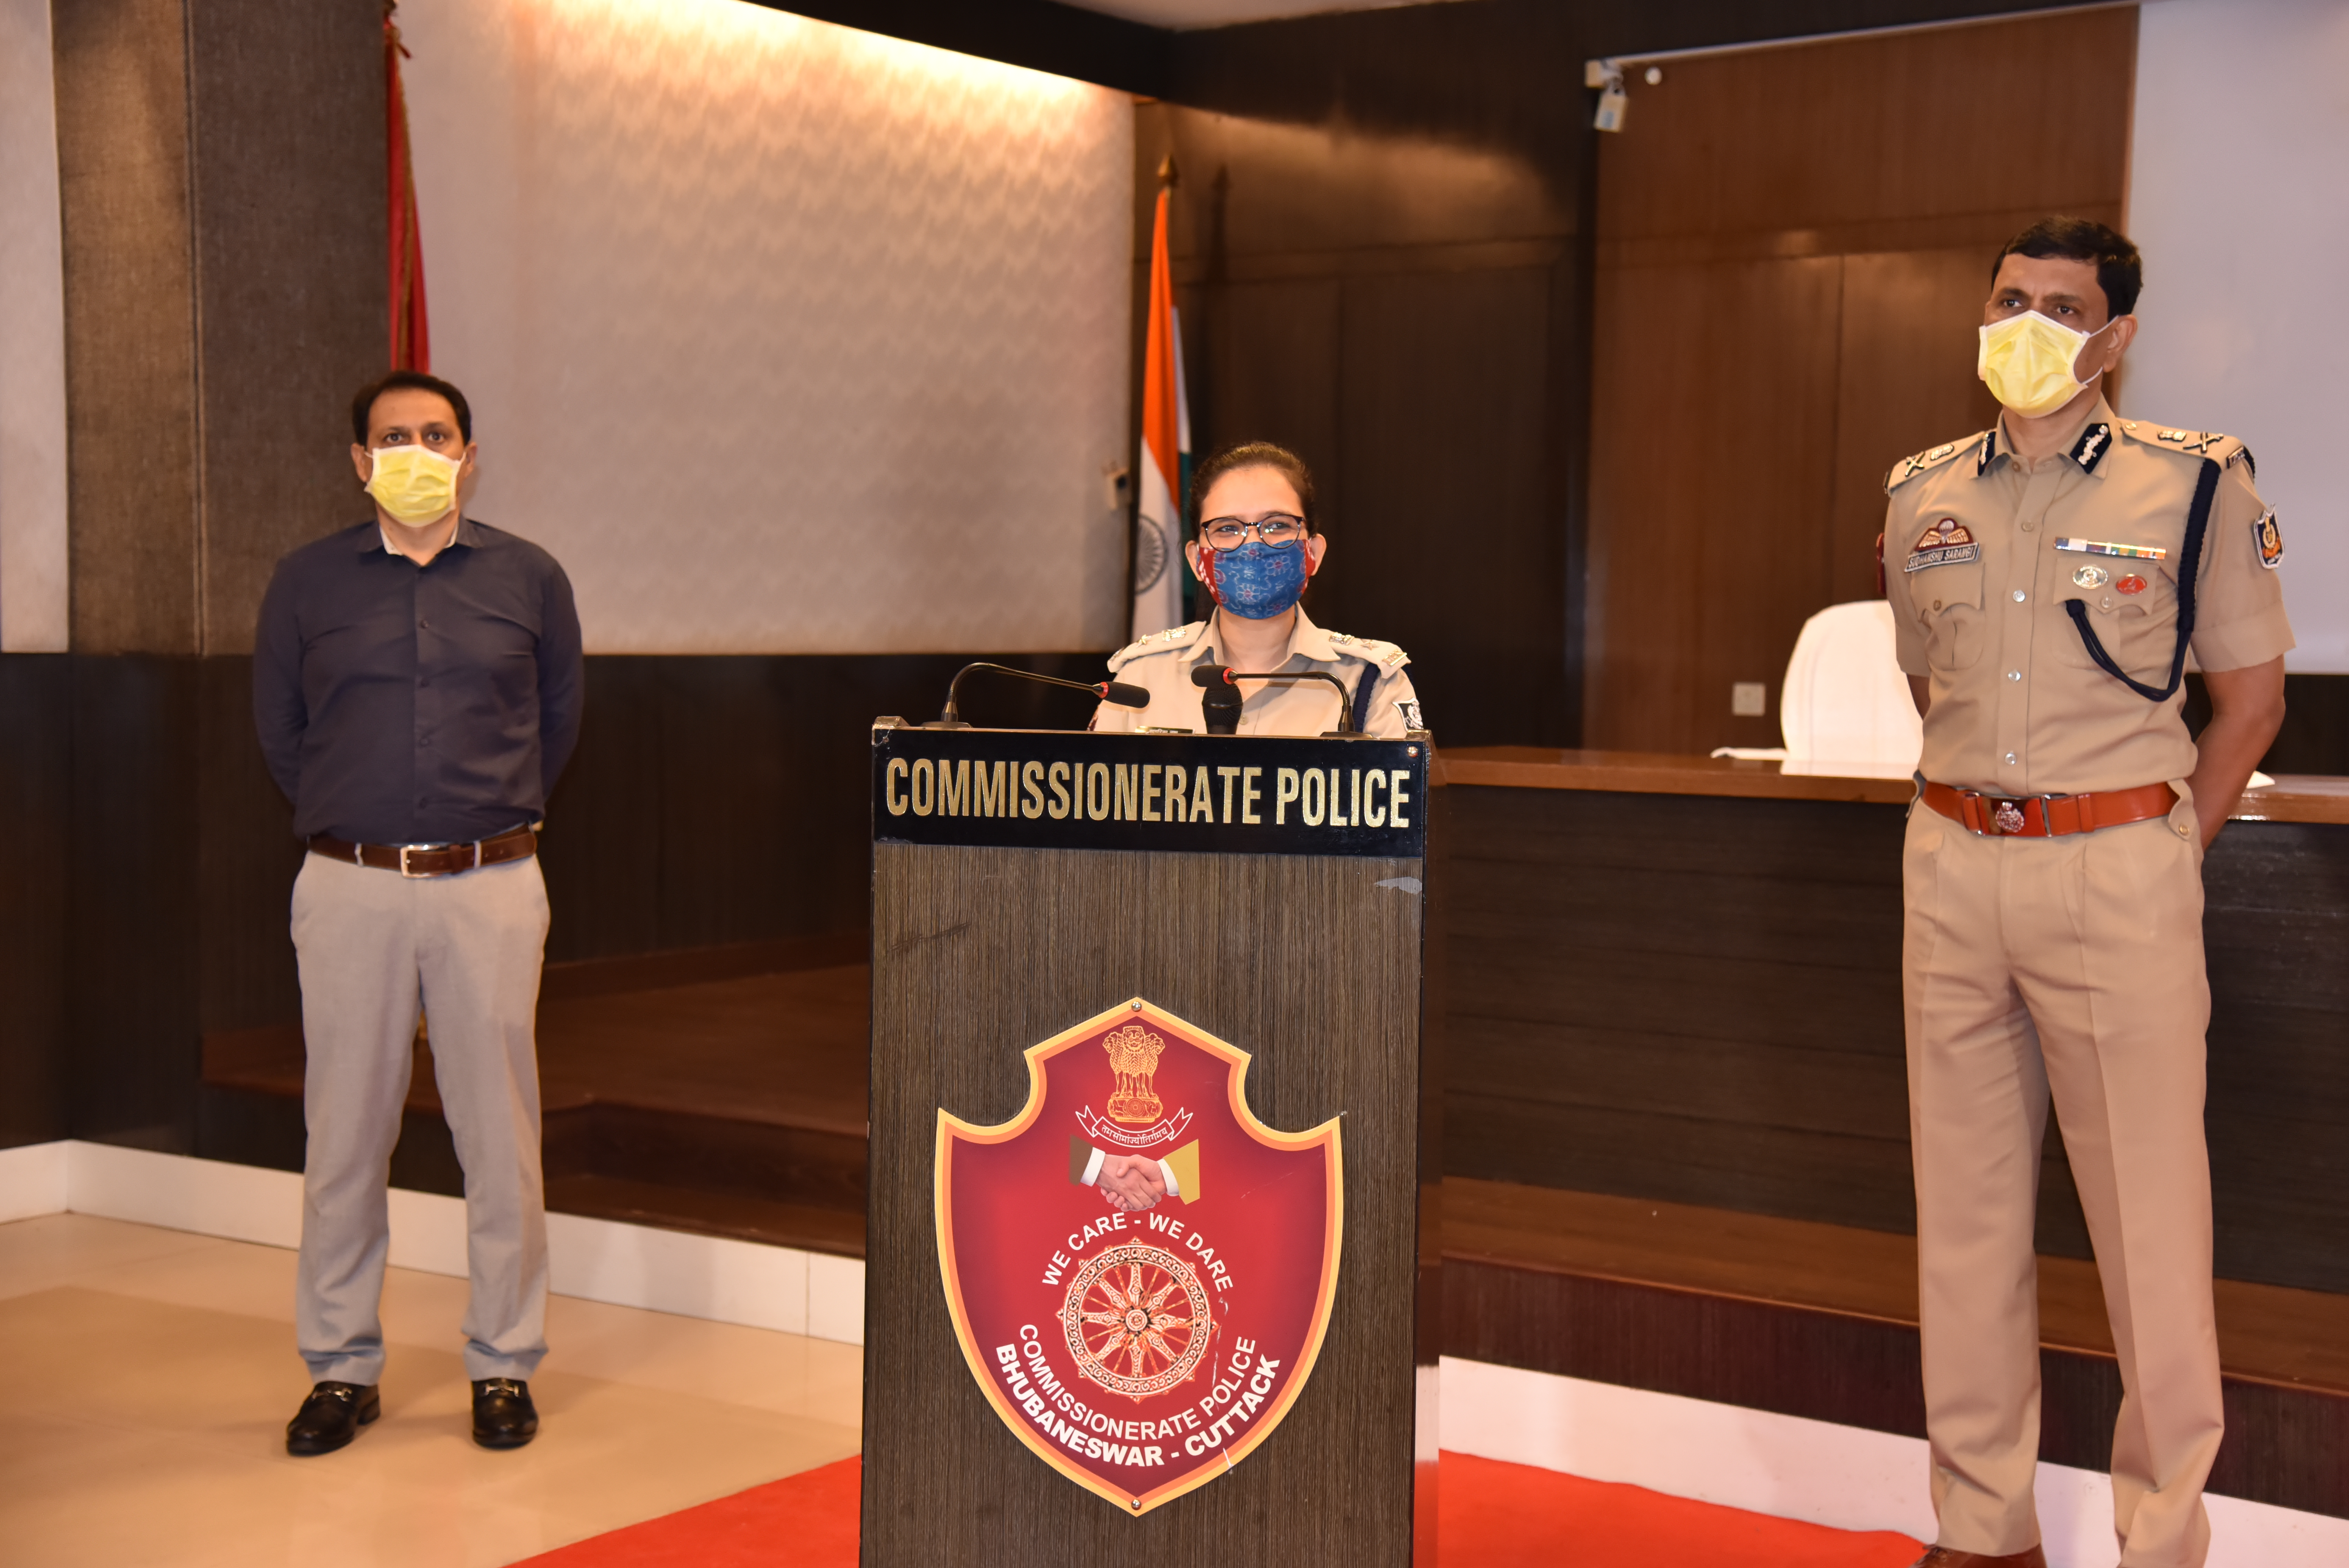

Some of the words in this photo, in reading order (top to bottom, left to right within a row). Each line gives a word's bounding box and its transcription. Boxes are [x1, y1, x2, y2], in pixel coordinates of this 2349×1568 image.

[1909, 551, 1944, 568] SUDHANSHU
[1944, 546, 1973, 560] SARANGI
[887, 758, 1262, 824] COMMISSIONERATE
[1276, 768, 1410, 828] POLICE
[1042, 1250, 1071, 1285] WE
[1069, 1212, 1127, 1251] CARE
[1150, 1212, 1185, 1239] WE
[1185, 1232, 1233, 1292] DARE
[996, 1343, 1165, 1467] BHUBANESWAR
[1185, 1354, 1280, 1456] CUTTACK
[1020, 1324, 1201, 1440] COMMISSIONERATE
[1199, 1336, 1256, 1417] POLICE
